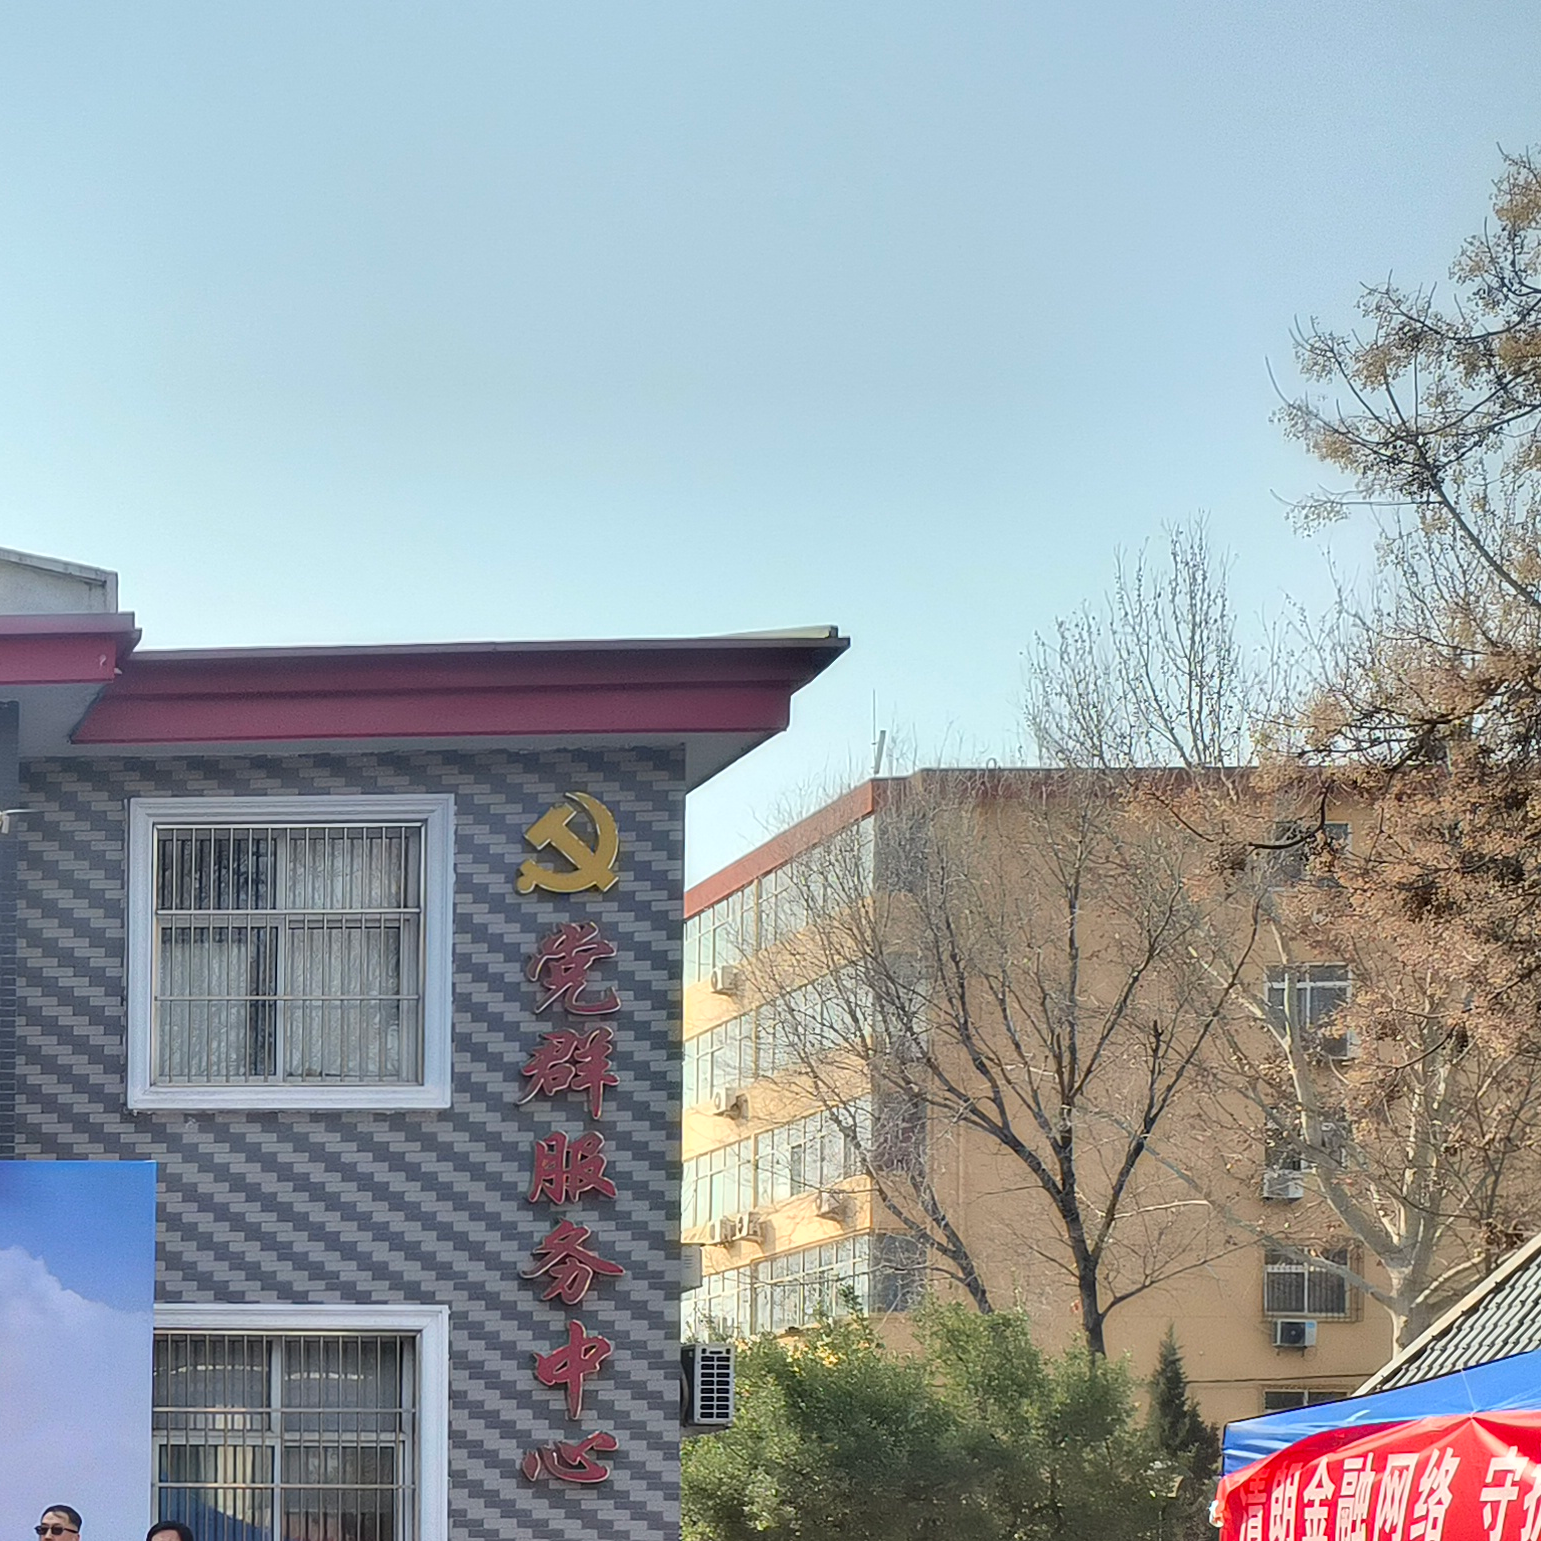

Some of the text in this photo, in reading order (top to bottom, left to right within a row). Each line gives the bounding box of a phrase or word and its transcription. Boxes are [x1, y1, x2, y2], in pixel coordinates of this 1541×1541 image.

[517, 921, 625, 1483] 党群服务中心
